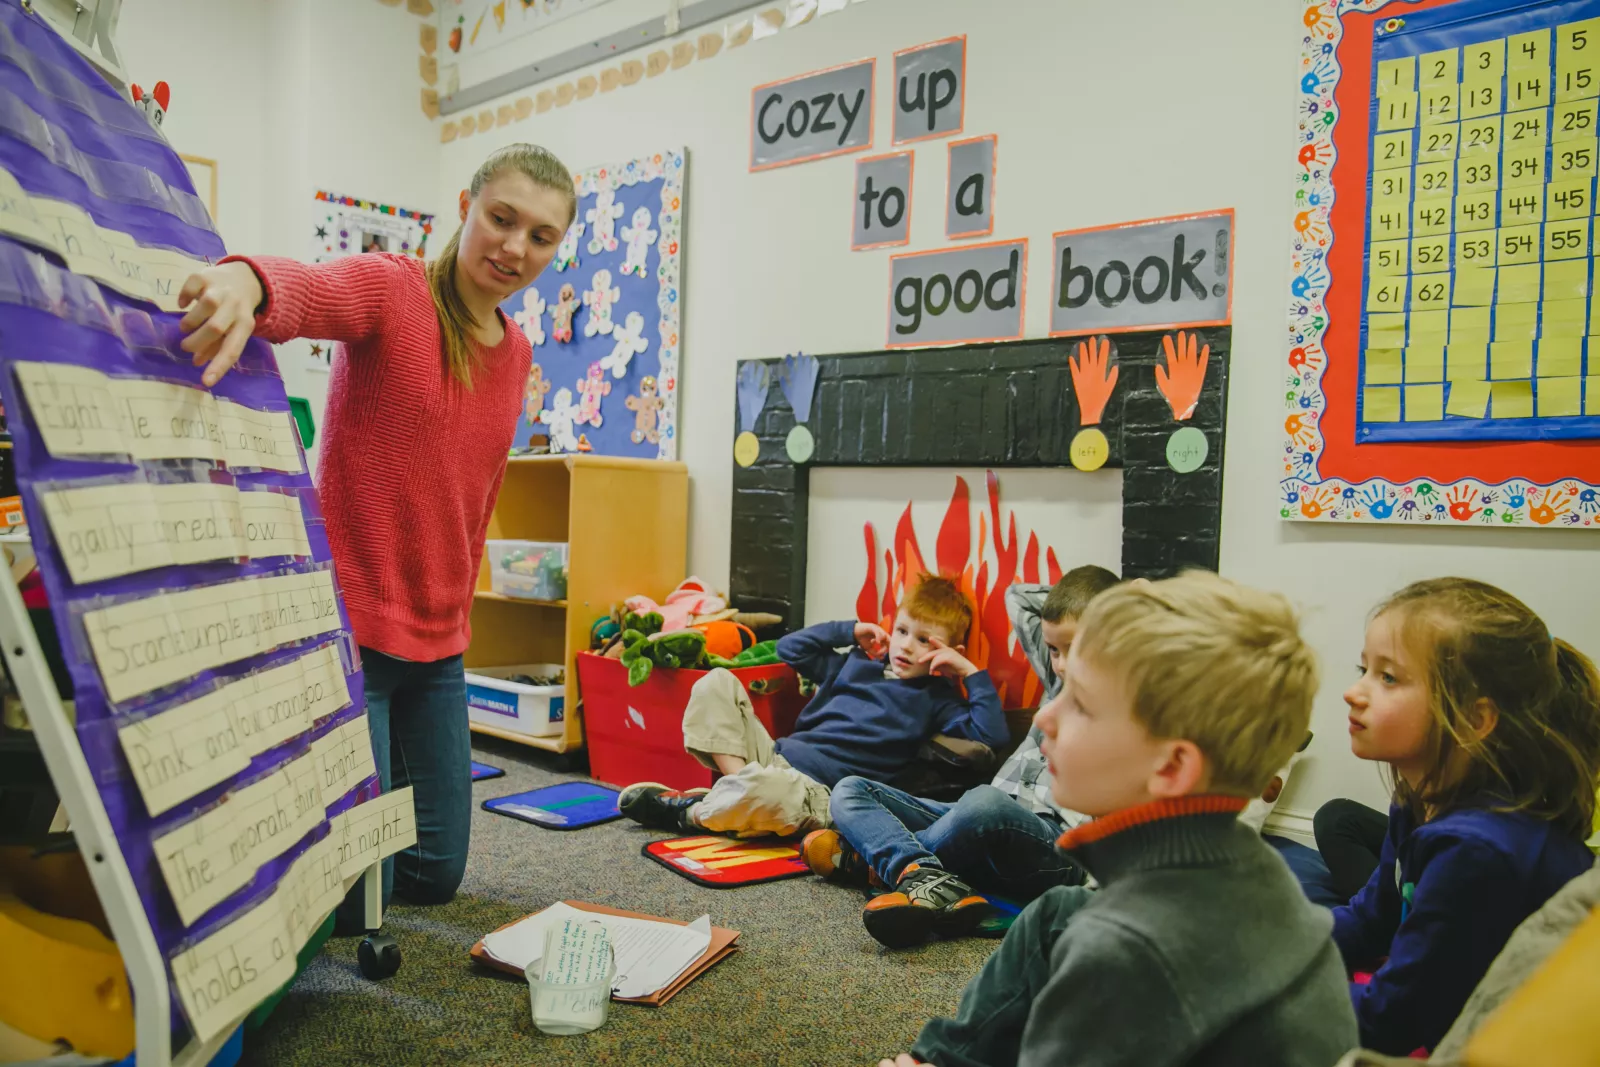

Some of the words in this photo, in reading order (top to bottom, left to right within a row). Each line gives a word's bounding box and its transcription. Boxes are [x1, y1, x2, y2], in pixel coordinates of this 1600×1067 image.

[1434, 61, 1446, 79] 2
[1479, 52, 1491, 70] 3
[1523, 42, 1536, 59] 4
[1572, 31, 1588, 51] 5
[757, 89, 865, 146] Cozy
[899, 69, 957, 130] up
[1390, 103, 1407, 119] 11
[1429, 96, 1451, 115] 12
[1470, 88, 1493, 107] 13
[1518, 79, 1541, 100] 14
[1566, 69, 1592, 91] 15
[1384, 141, 1404, 160] 21
[1428, 134, 1452, 152] 22
[1470, 127, 1495, 147] 23
[1513, 119, 1540, 139] 24
[1564, 110, 1591, 130] 25
[1383, 178, 1403, 195] 31
[1423, 172, 1447, 190] 32
[1466, 165, 1491, 184] 33
[1511, 158, 1538, 177] 34
[1561, 149, 1590, 170] 35
[859, 176, 905, 230] to
[955, 173, 984, 216] a
[1380, 214, 1401, 230] 41
[1420, 209, 1445, 226] 42
[1463, 203, 1489, 220] 43
[1509, 196, 1537, 214] 44
[1554, 189, 1584, 209] 45
[1379, 250, 1400, 267] 51
[1418, 246, 1444, 263] 52
[1463, 241, 1489, 258] 53
[1504, 235, 1533, 254] 54
[1551, 230, 1581, 249] 55
[894, 249, 1019, 334] good
[1058, 229, 1228, 308] book!
[1377, 287, 1399, 302] 61
[1418, 284, 1444, 301] 62
[1078, 446, 1097, 457] left
[1173, 444, 1199, 463] right
[133, 731, 193, 789] Pink
[168, 849, 215, 898] The
[184, 945, 257, 1017] holds
